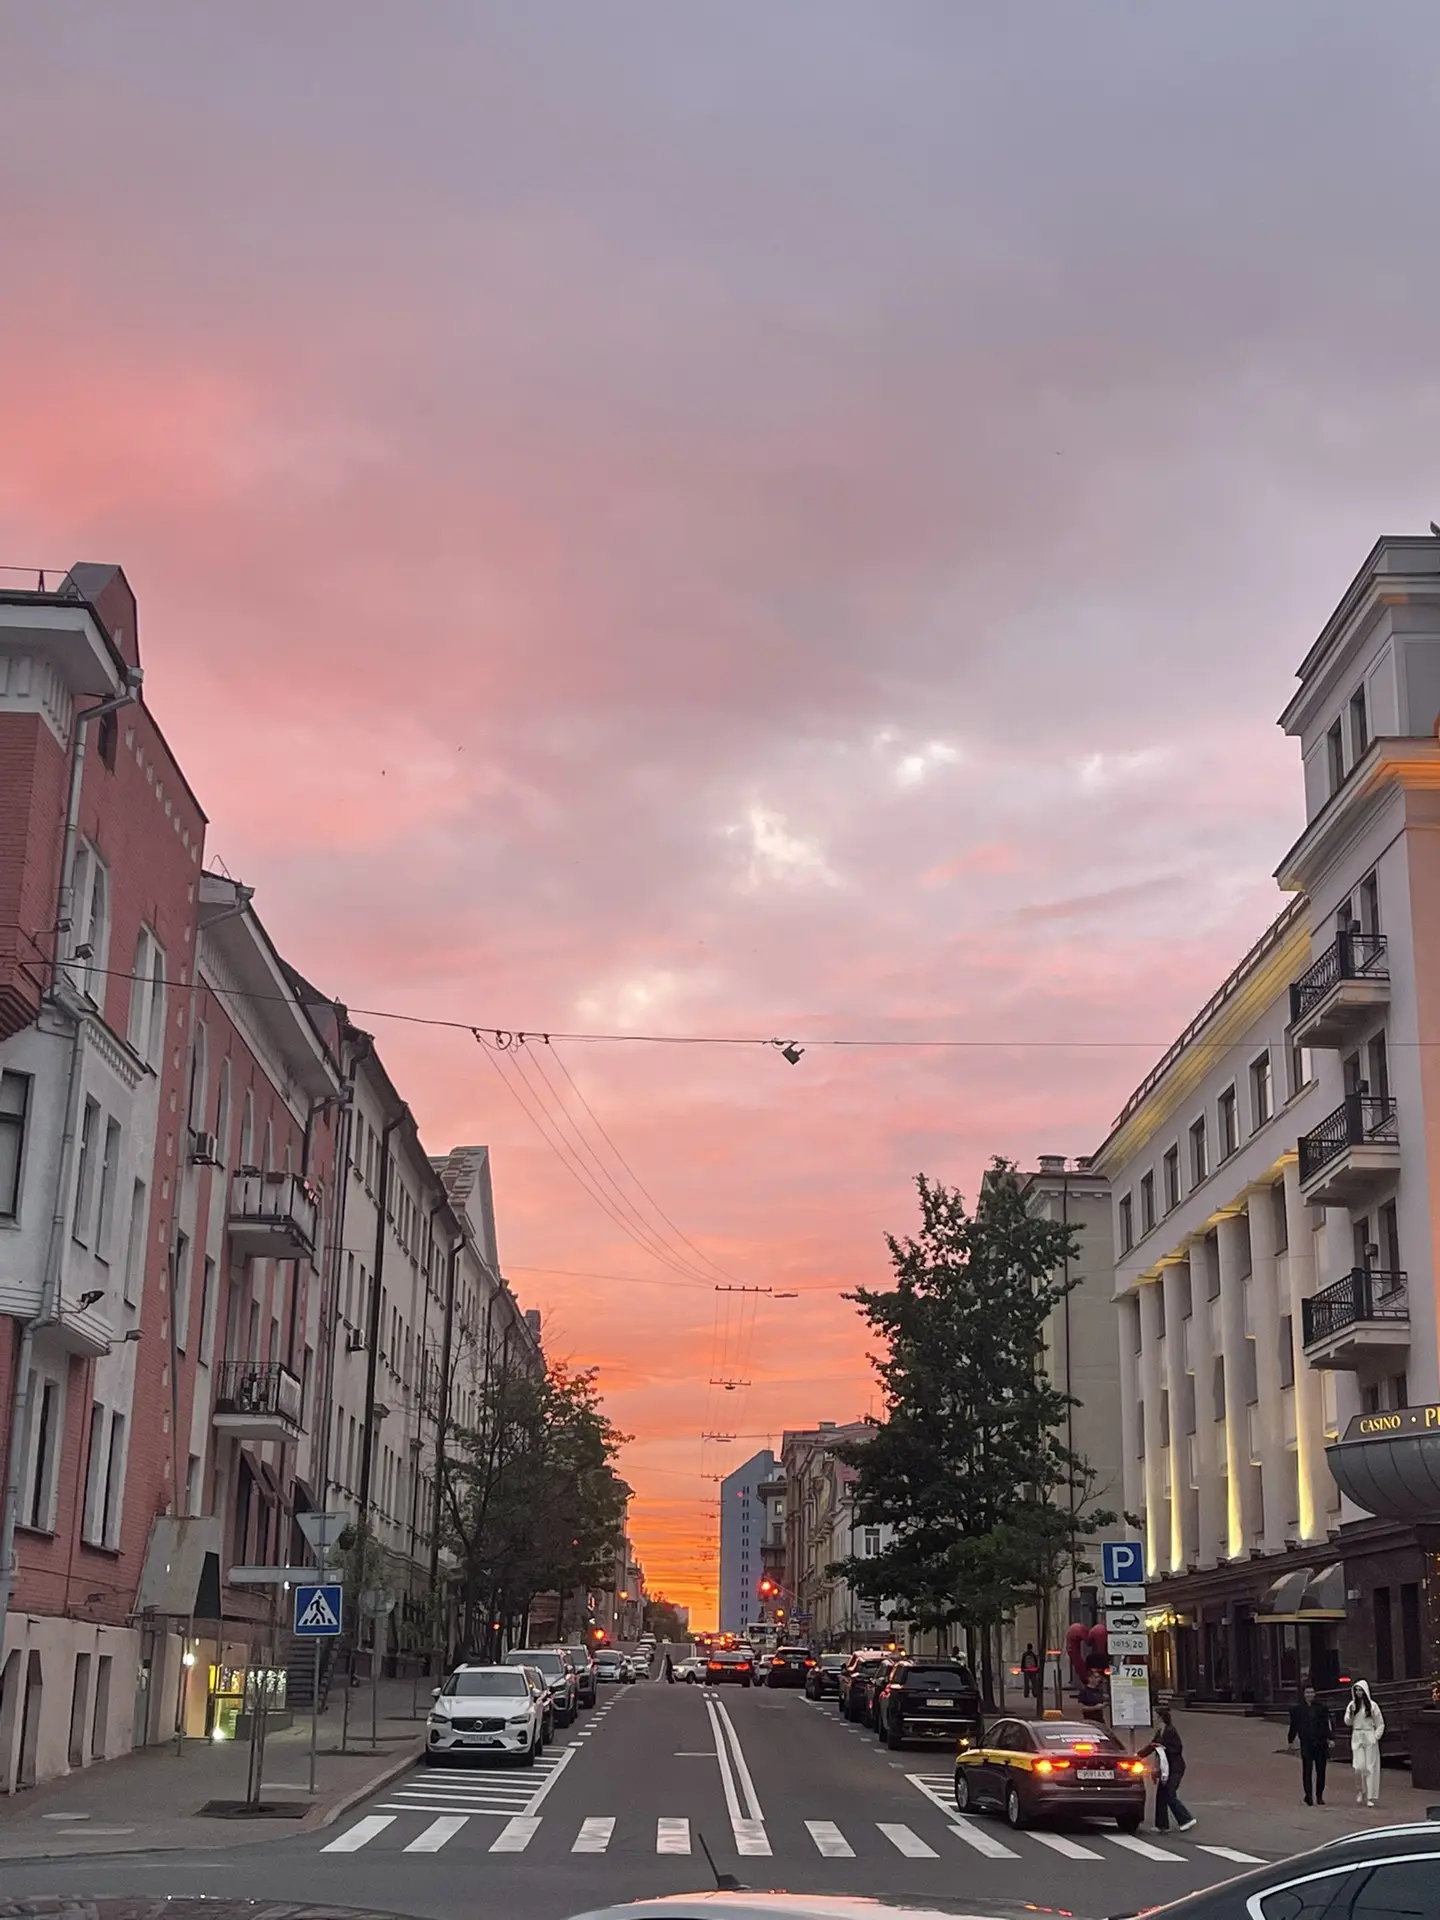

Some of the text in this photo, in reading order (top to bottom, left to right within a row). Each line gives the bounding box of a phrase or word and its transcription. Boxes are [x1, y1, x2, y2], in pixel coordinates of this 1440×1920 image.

[1360, 1415, 1401, 1433] CASINO
[1111, 1546, 1135, 1579] P
[1132, 1640, 1144, 1649] 20
[1125, 1667, 1144, 1678] 720
